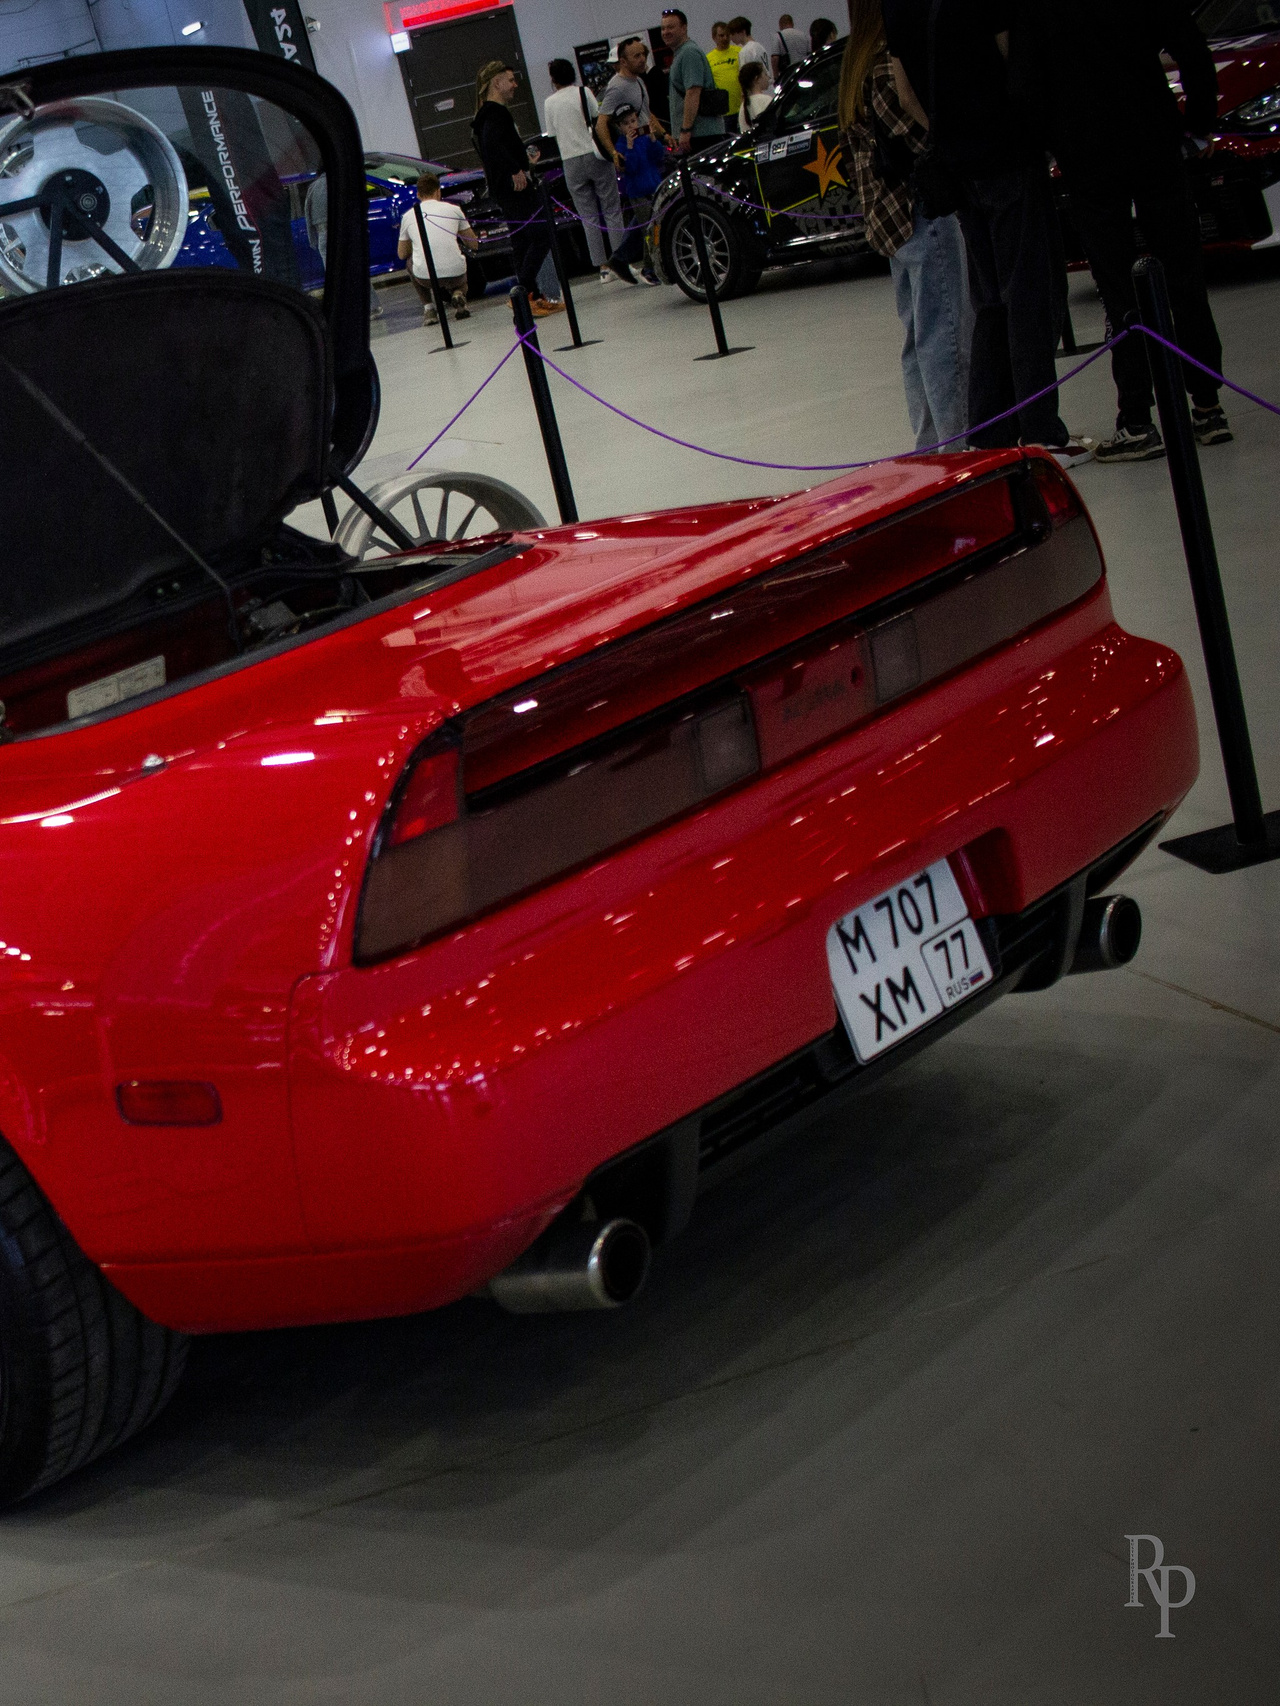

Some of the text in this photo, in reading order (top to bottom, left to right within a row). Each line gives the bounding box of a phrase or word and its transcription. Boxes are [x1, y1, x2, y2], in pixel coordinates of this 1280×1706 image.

[201, 90, 257, 232] PERFORMANCE
[873, 873, 939, 949] 707
[933, 929, 970, 980] 77
[945, 977, 970, 999] RUS
